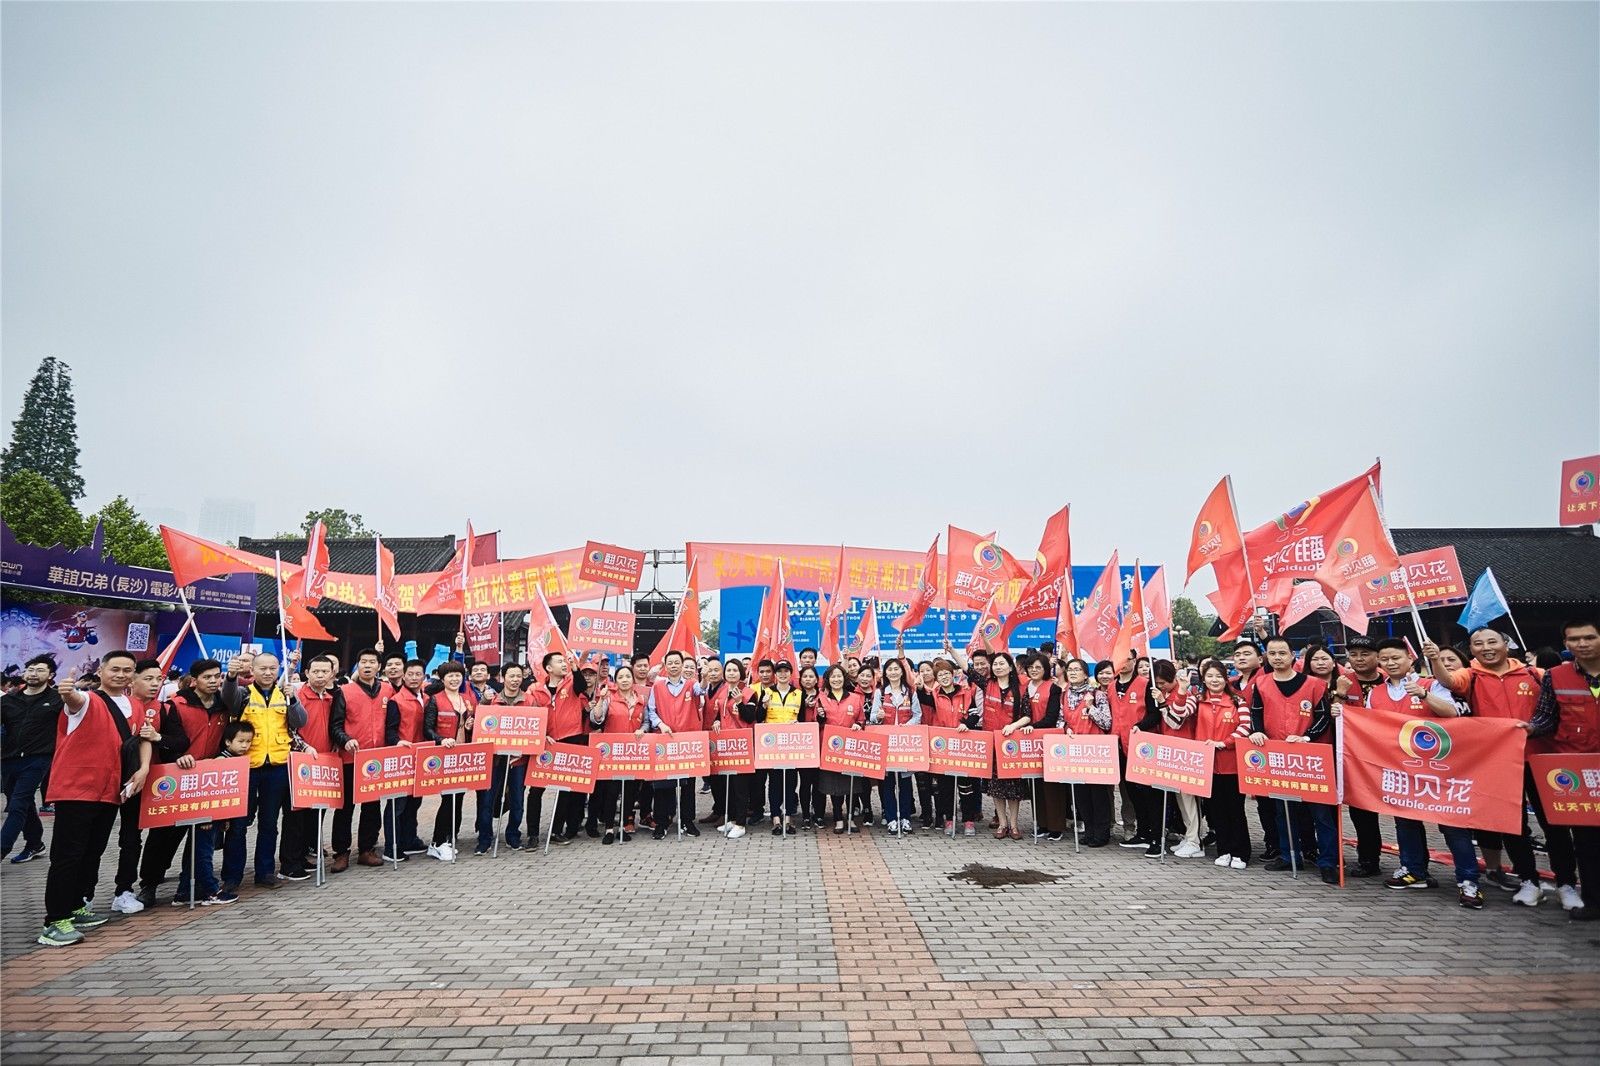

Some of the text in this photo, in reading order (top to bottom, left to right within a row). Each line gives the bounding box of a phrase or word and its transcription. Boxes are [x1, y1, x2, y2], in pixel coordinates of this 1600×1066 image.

[1567, 501, 1600, 512] 让天下
[604, 553, 638, 570] 翻贝花
[1390, 560, 1448, 583] 翻贝花
[592, 618, 628, 632] 翻贝花
[500, 716, 540, 730] 翻贝花
[717, 738, 748, 752] 翻贝花
[777, 732, 813, 745] 翻贝花
[845, 737, 881, 756] 翻贝花
[948, 738, 986, 754] 翻贝花
[612, 742, 649, 756] 翻贝花
[666, 741, 703, 755] 翻贝花
[1069, 744, 1111, 758] 翻贝花
[1157, 745, 1204, 767] 翻贝花
[383, 755, 413, 772] 翻贝
[443, 752, 487, 769] 翻贝花
[554, 752, 593, 769] 翻贝花
[1268, 752, 1324, 772] 翻贝花
[180, 769, 239, 792] 翻贝花
[311, 764, 340, 782] 翻贝花
[1270, 768, 1326, 780] double.com.cn
[1244, 775, 1329, 793] 让天下没有闲置资源
[1381, 768, 1473, 803] 翻贝花
[180, 787, 240, 799] double.com.cn
[148, 797, 241, 816] 让天下没有闲置资源
[1382, 794, 1471, 815] double.com.cn
